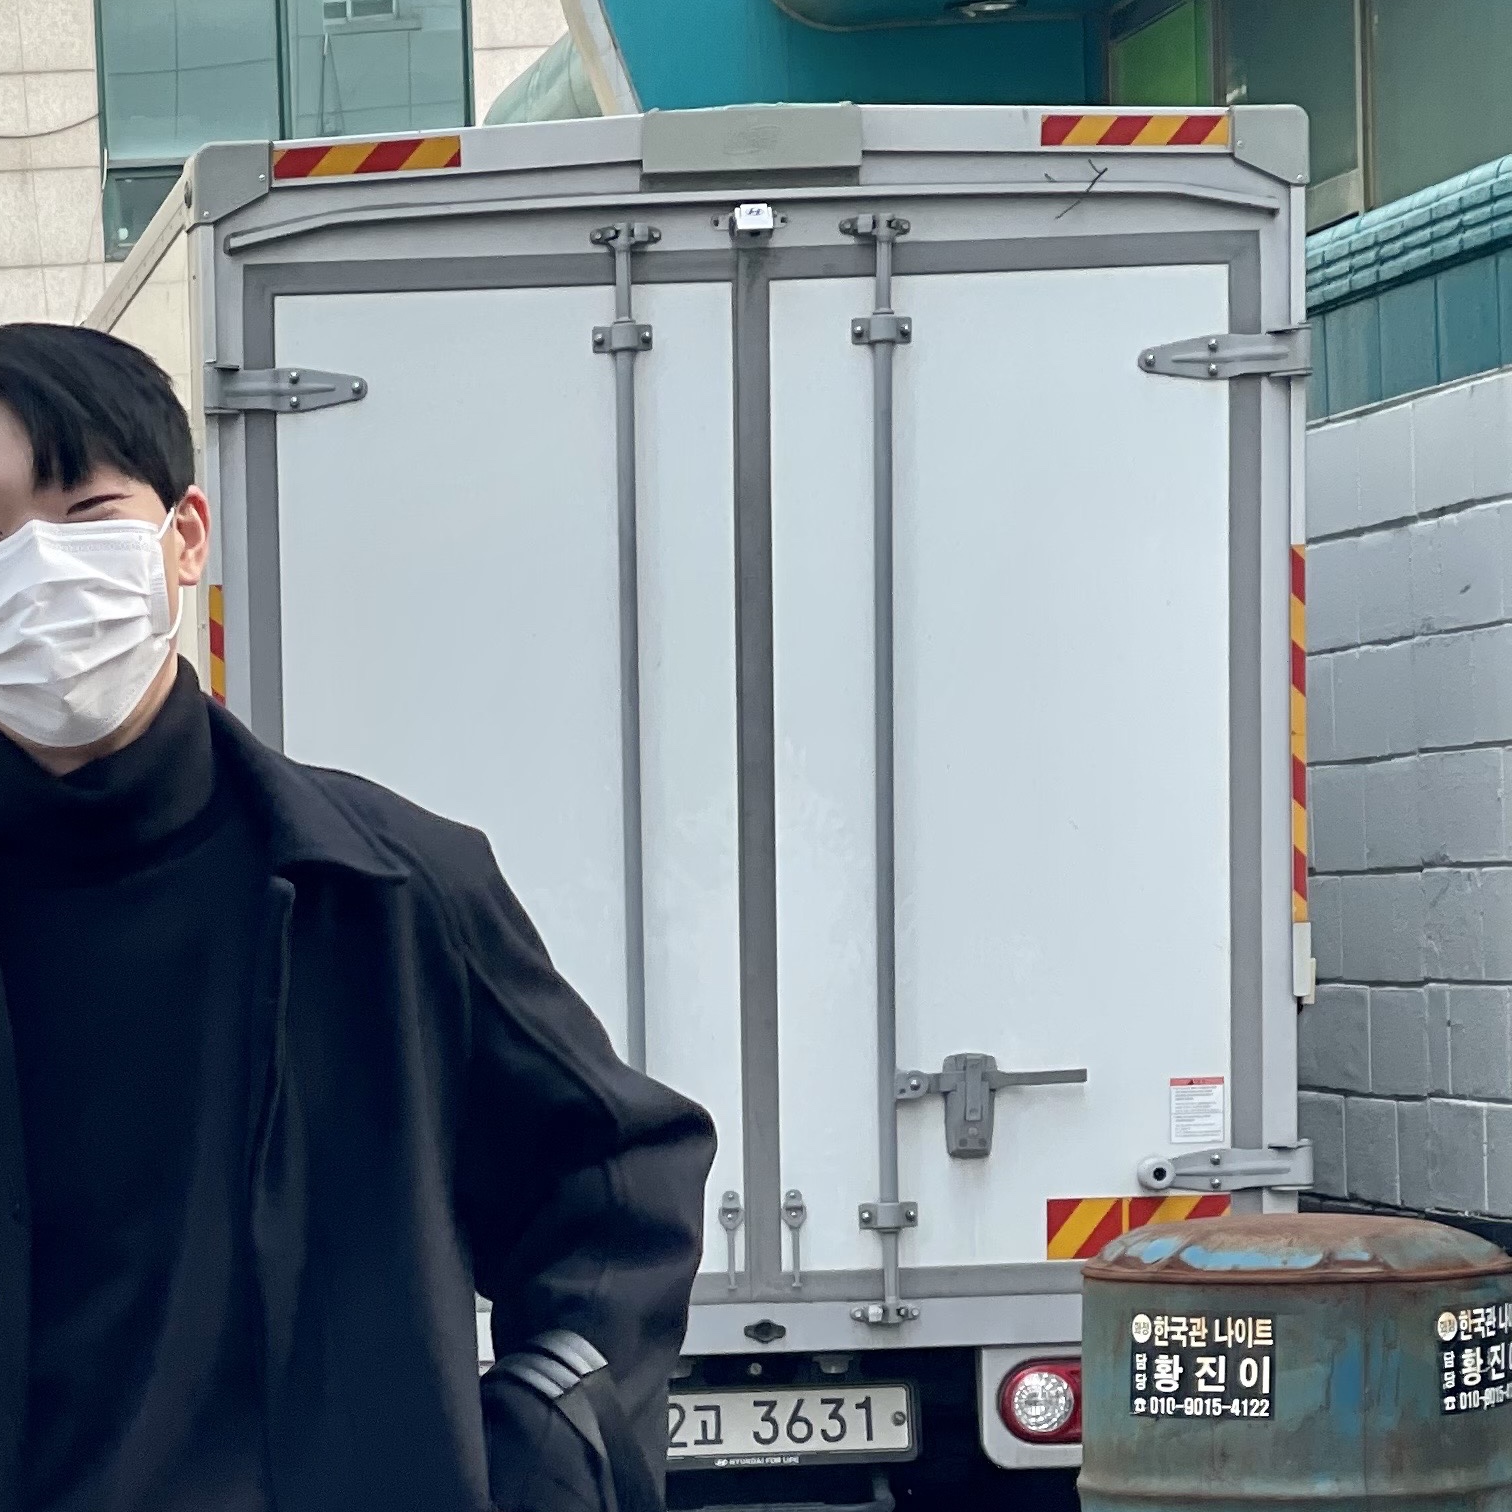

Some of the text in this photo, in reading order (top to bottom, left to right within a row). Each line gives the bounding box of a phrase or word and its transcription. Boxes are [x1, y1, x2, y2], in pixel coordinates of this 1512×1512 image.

[1153, 1315, 1208, 1348] 한국관
[1214, 1316, 1274, 1348] 나이트
[1458, 1305, 1497, 1341] 한국관
[752, 1396, 874, 1446] 3631
[1149, 1396, 1271, 1418] 010-9015-4122
[729, 1457, 765, 1466] HYUNDAI
